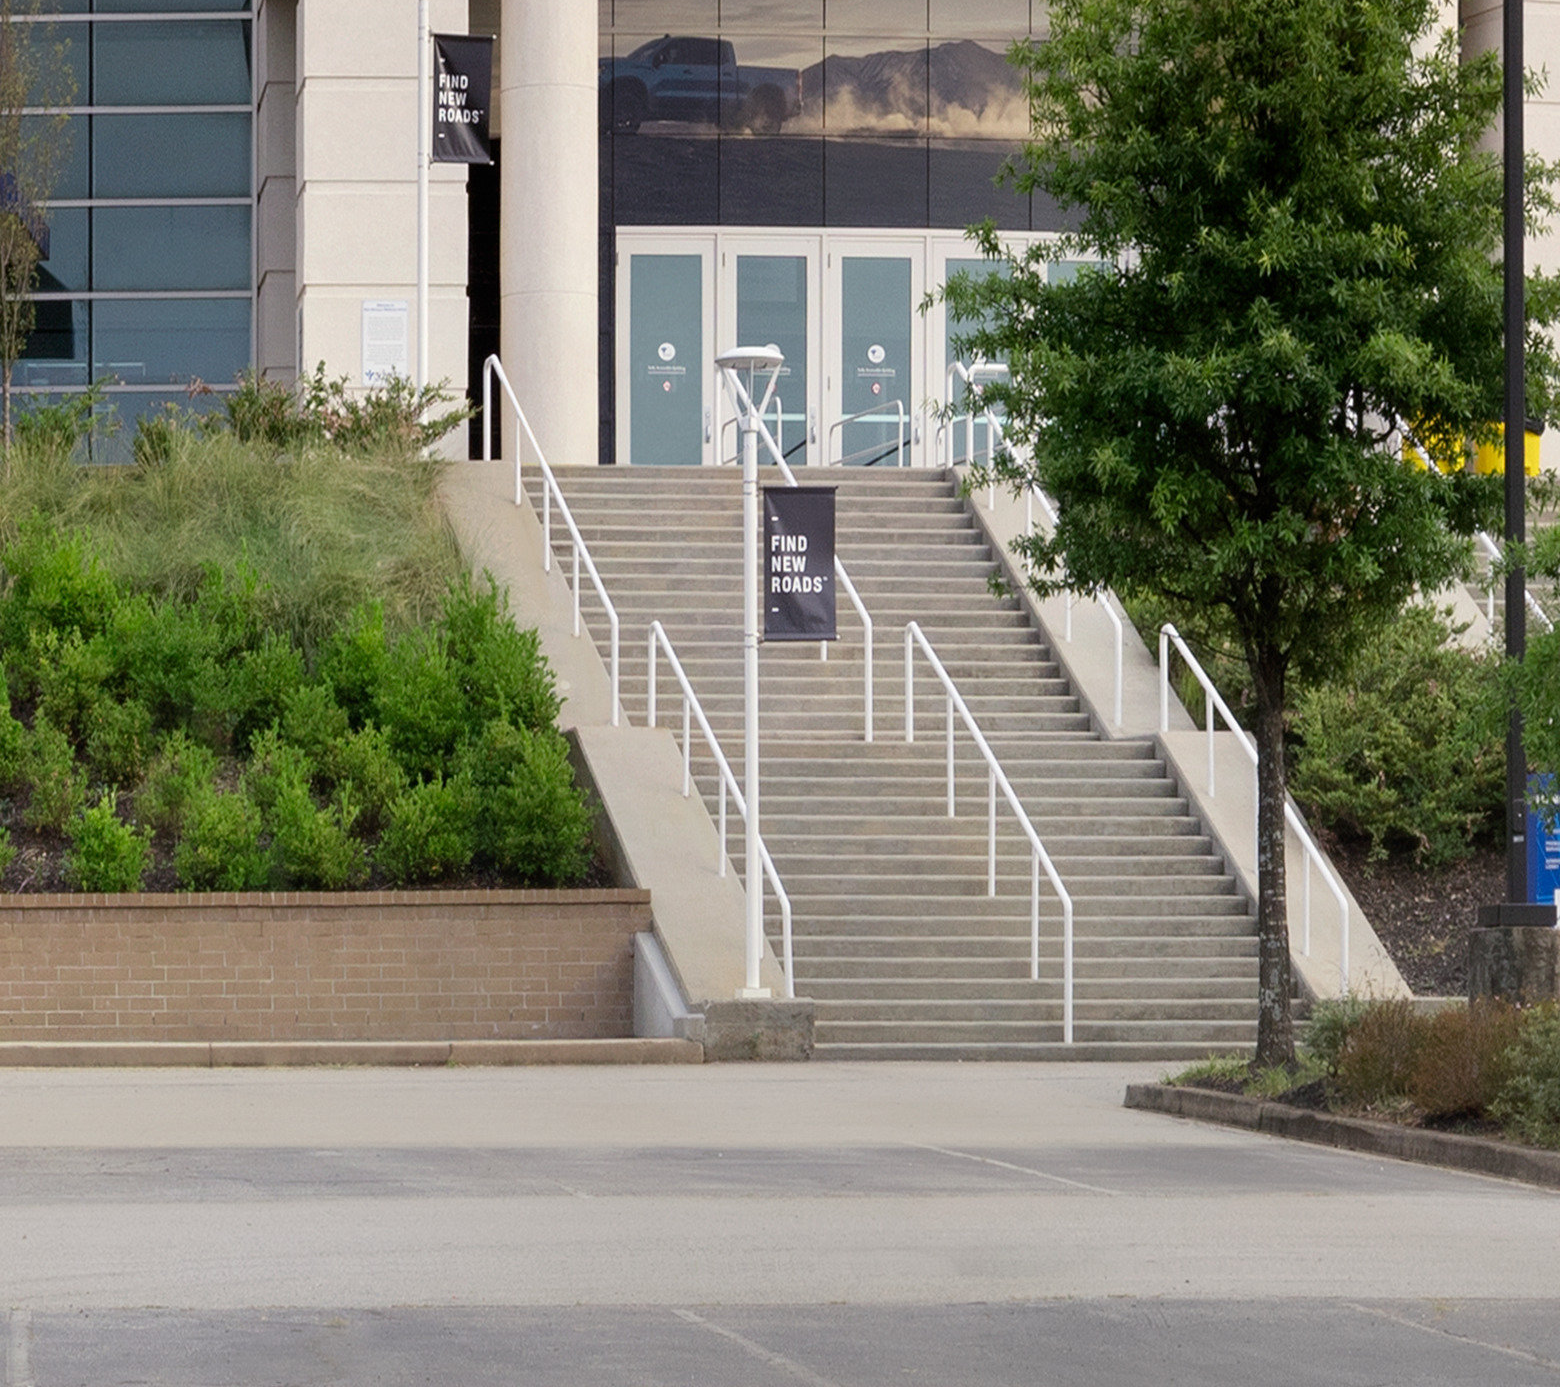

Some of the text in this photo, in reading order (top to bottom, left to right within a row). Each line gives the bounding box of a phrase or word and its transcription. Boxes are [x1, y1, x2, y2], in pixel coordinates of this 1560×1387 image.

[438, 73, 469, 89] FIND
[438, 91, 468, 106] NEW
[771, 535, 809, 552] FIND
[771, 555, 807, 573] NEW
